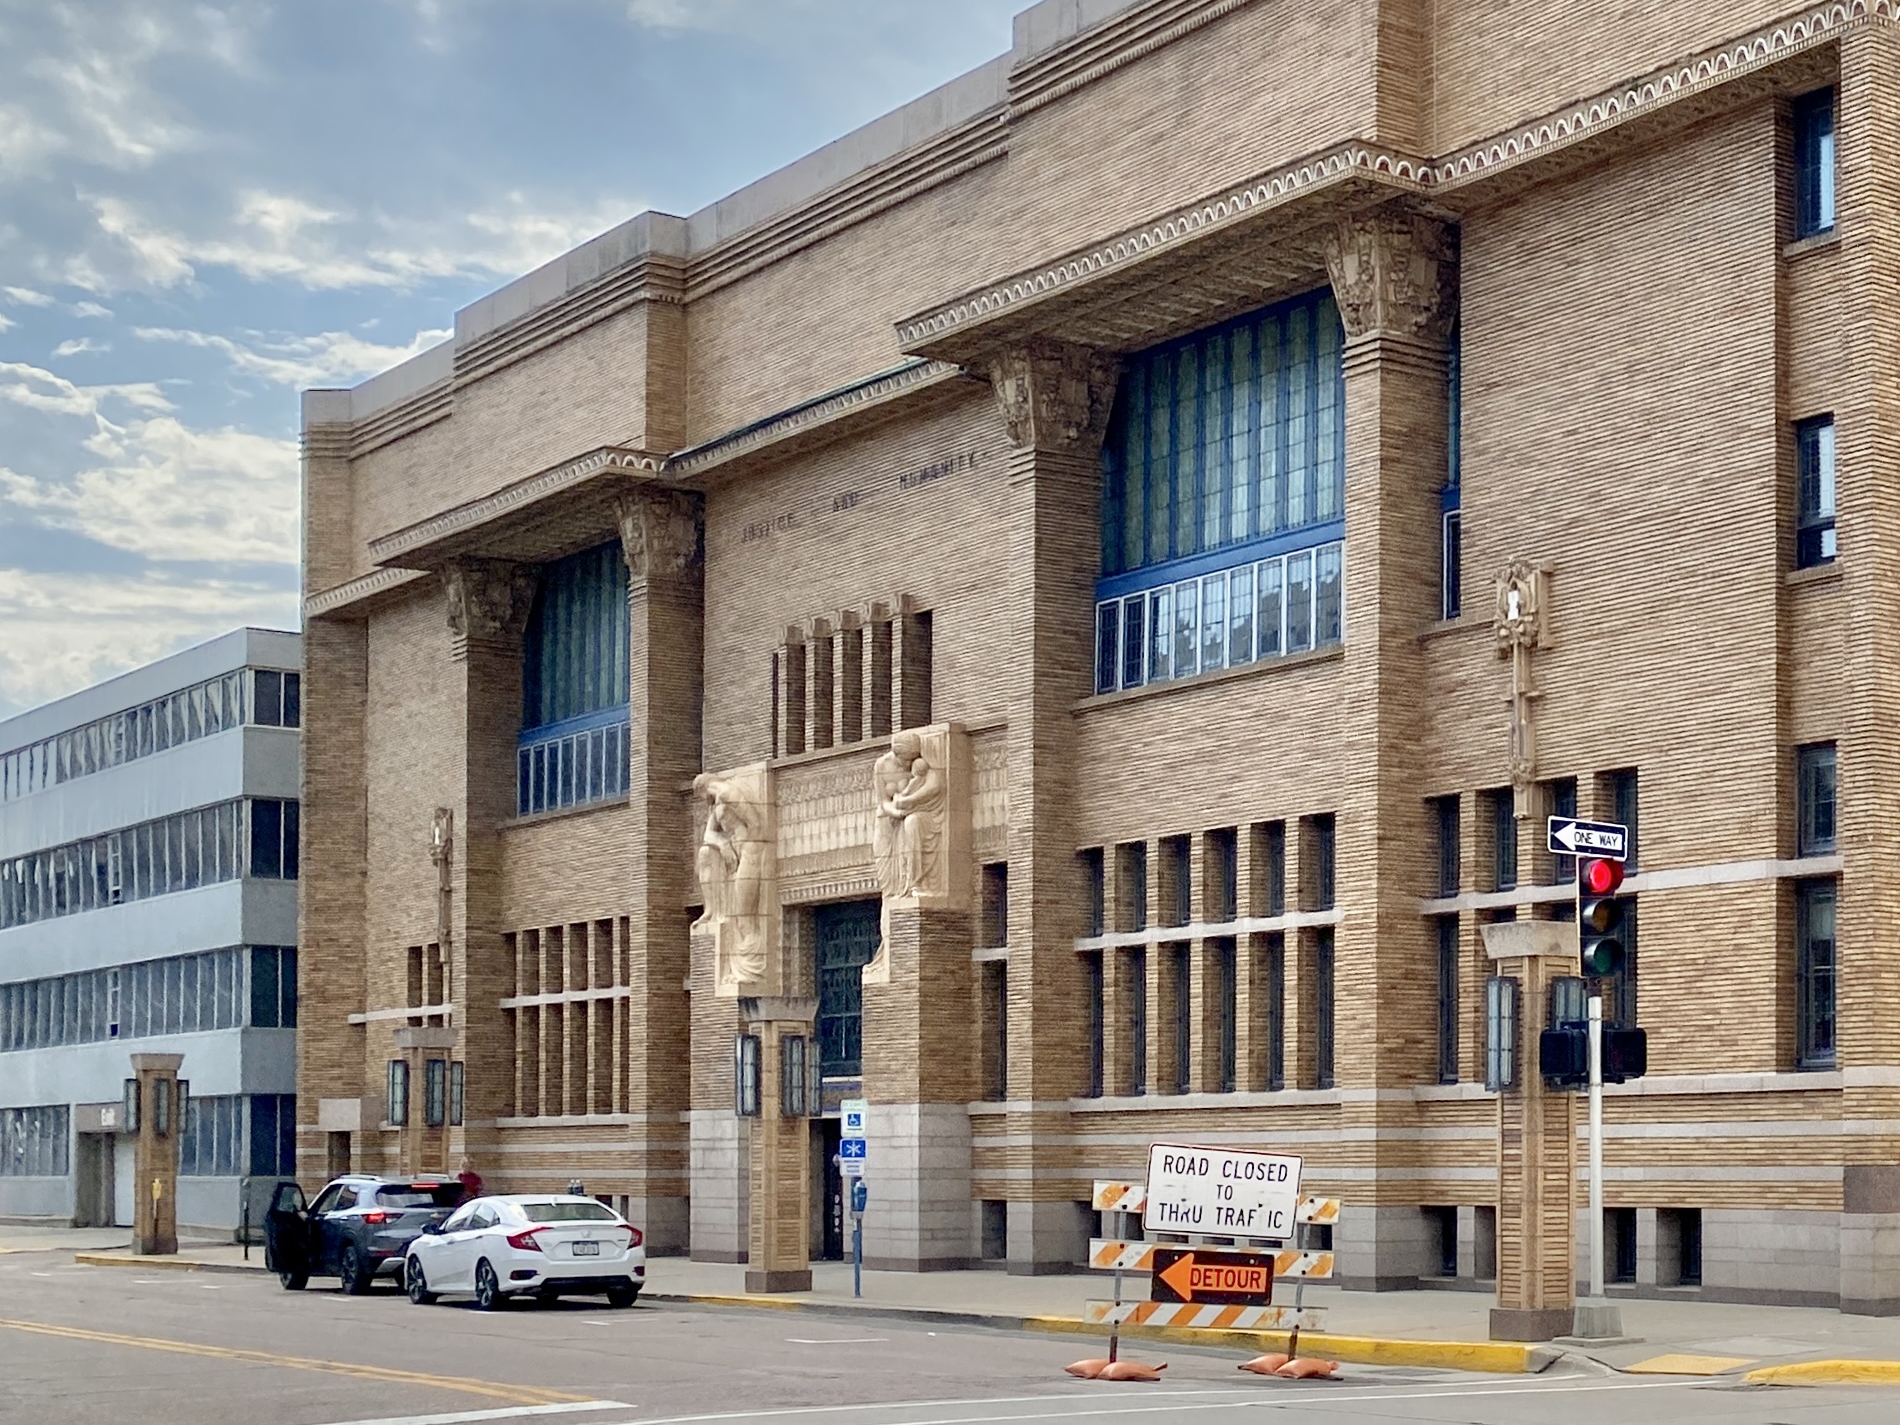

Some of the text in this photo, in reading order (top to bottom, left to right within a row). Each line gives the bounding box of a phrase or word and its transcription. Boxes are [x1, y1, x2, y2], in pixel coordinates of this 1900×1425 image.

[1574, 831, 1619, 847] ONE WAY
[1163, 1155, 1288, 1182] ROAD CLOSED
[1216, 1184, 1233, 1201] TO
[1190, 1267, 1262, 1289] DETOUR
